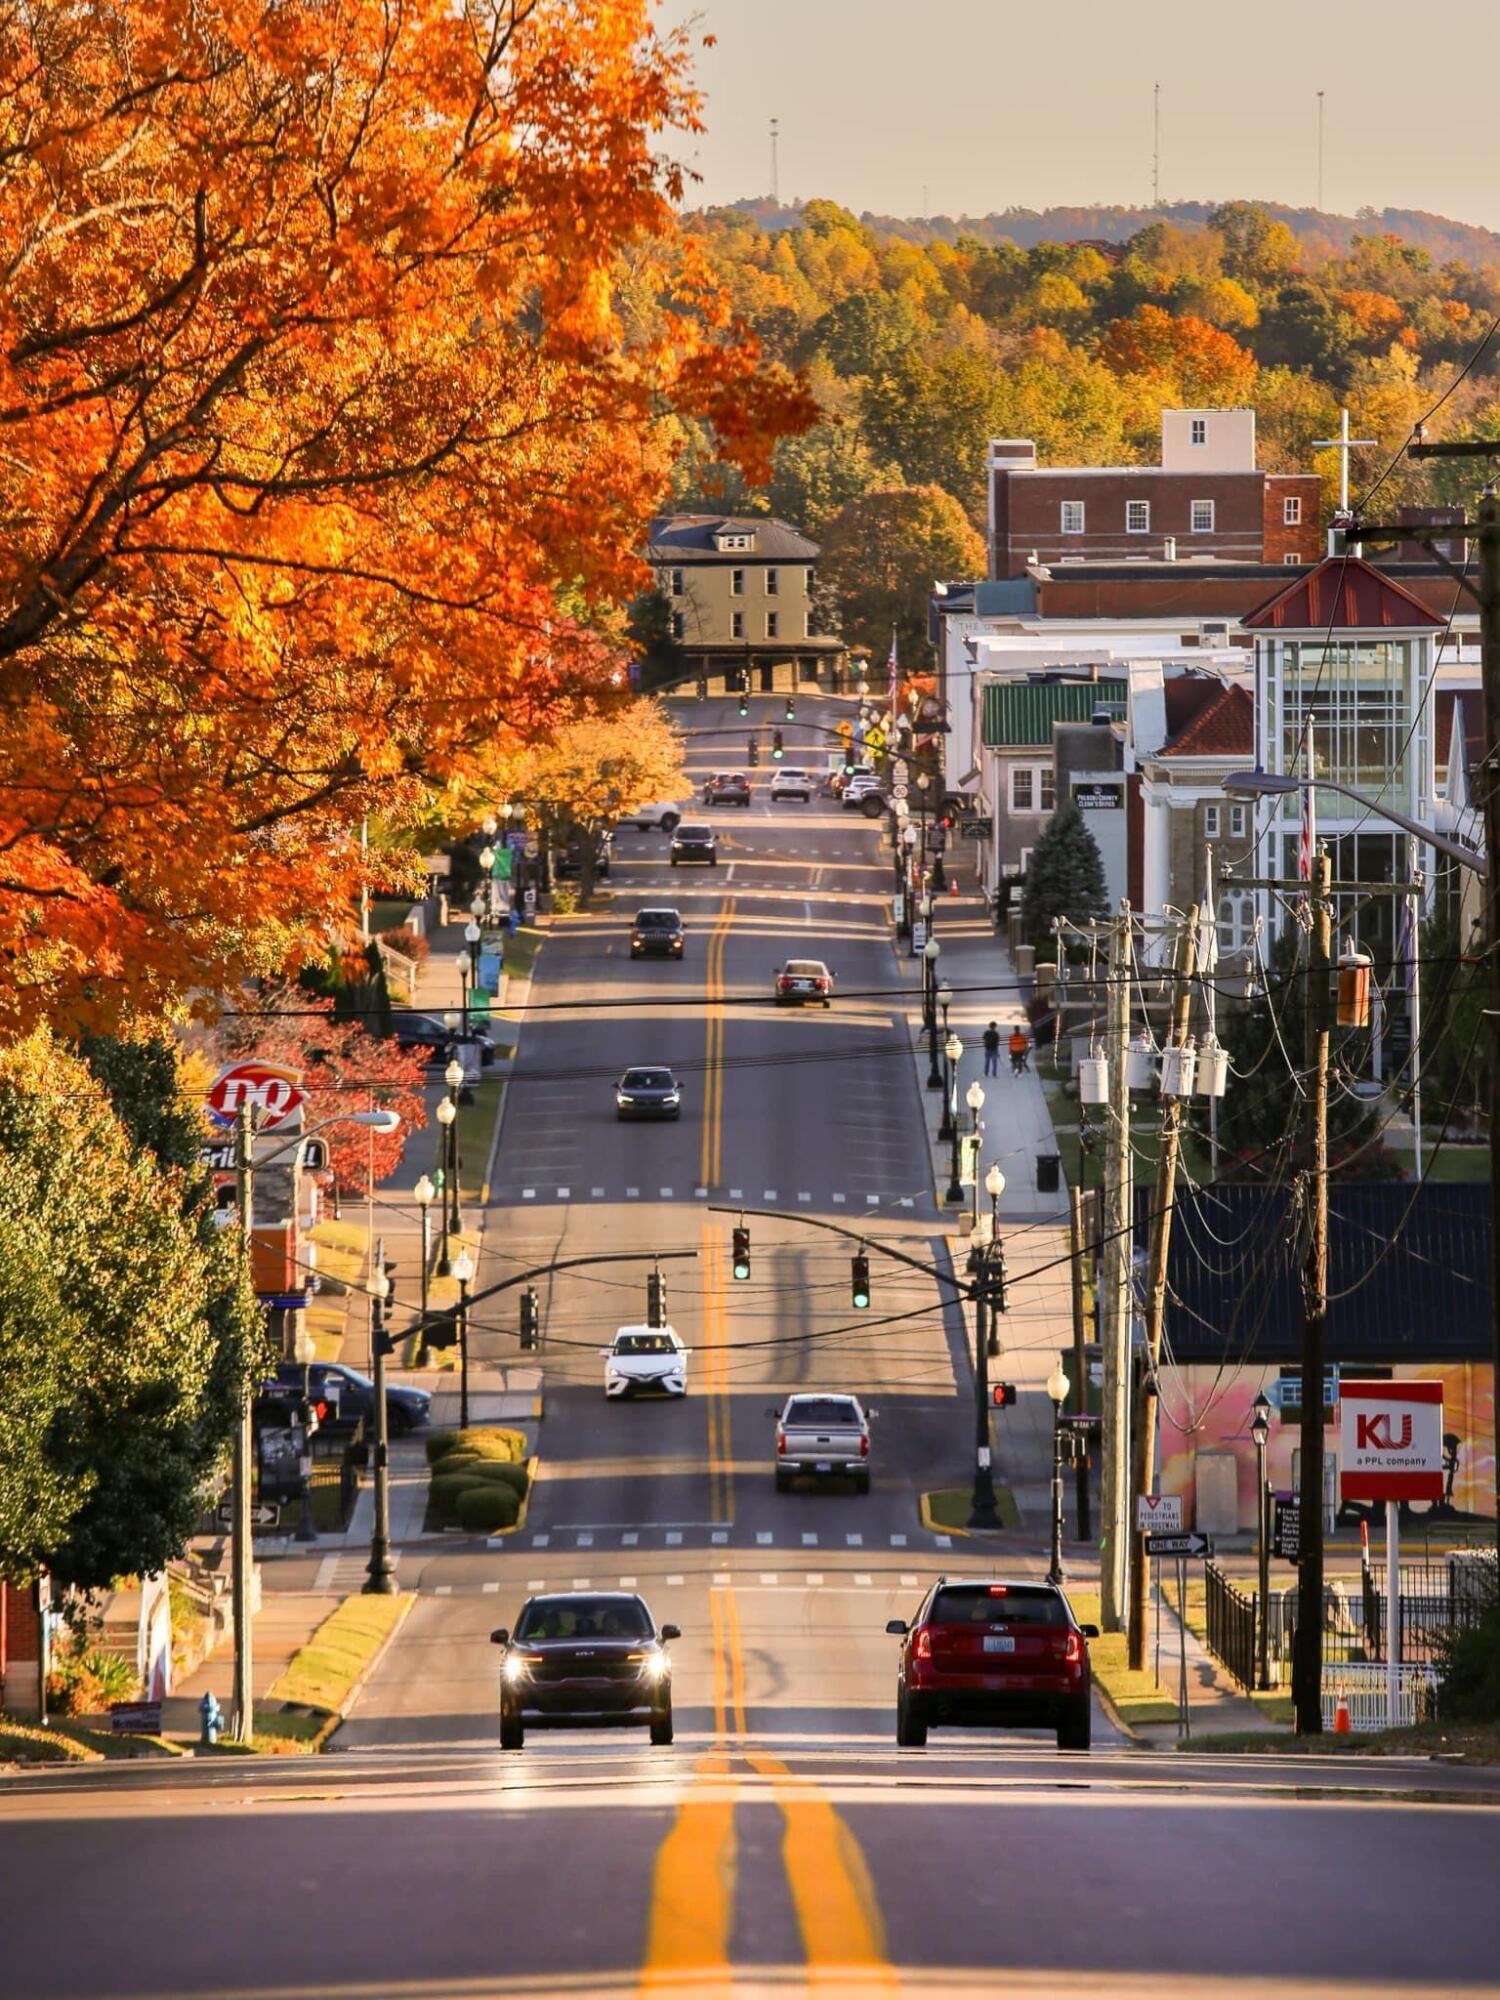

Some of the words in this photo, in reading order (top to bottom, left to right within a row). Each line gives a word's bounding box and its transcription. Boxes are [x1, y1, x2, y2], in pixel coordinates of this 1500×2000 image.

[219, 1078, 292, 1118] DQ
[1356, 1413, 1412, 1450] KU
[1365, 1456, 1383, 1465] PPL
[1386, 1457, 1427, 1467] company
[1163, 1502, 1172, 1510] TO
[1151, 1540, 1167, 1550] ONE
[1171, 1540, 1188, 1549] WAY
